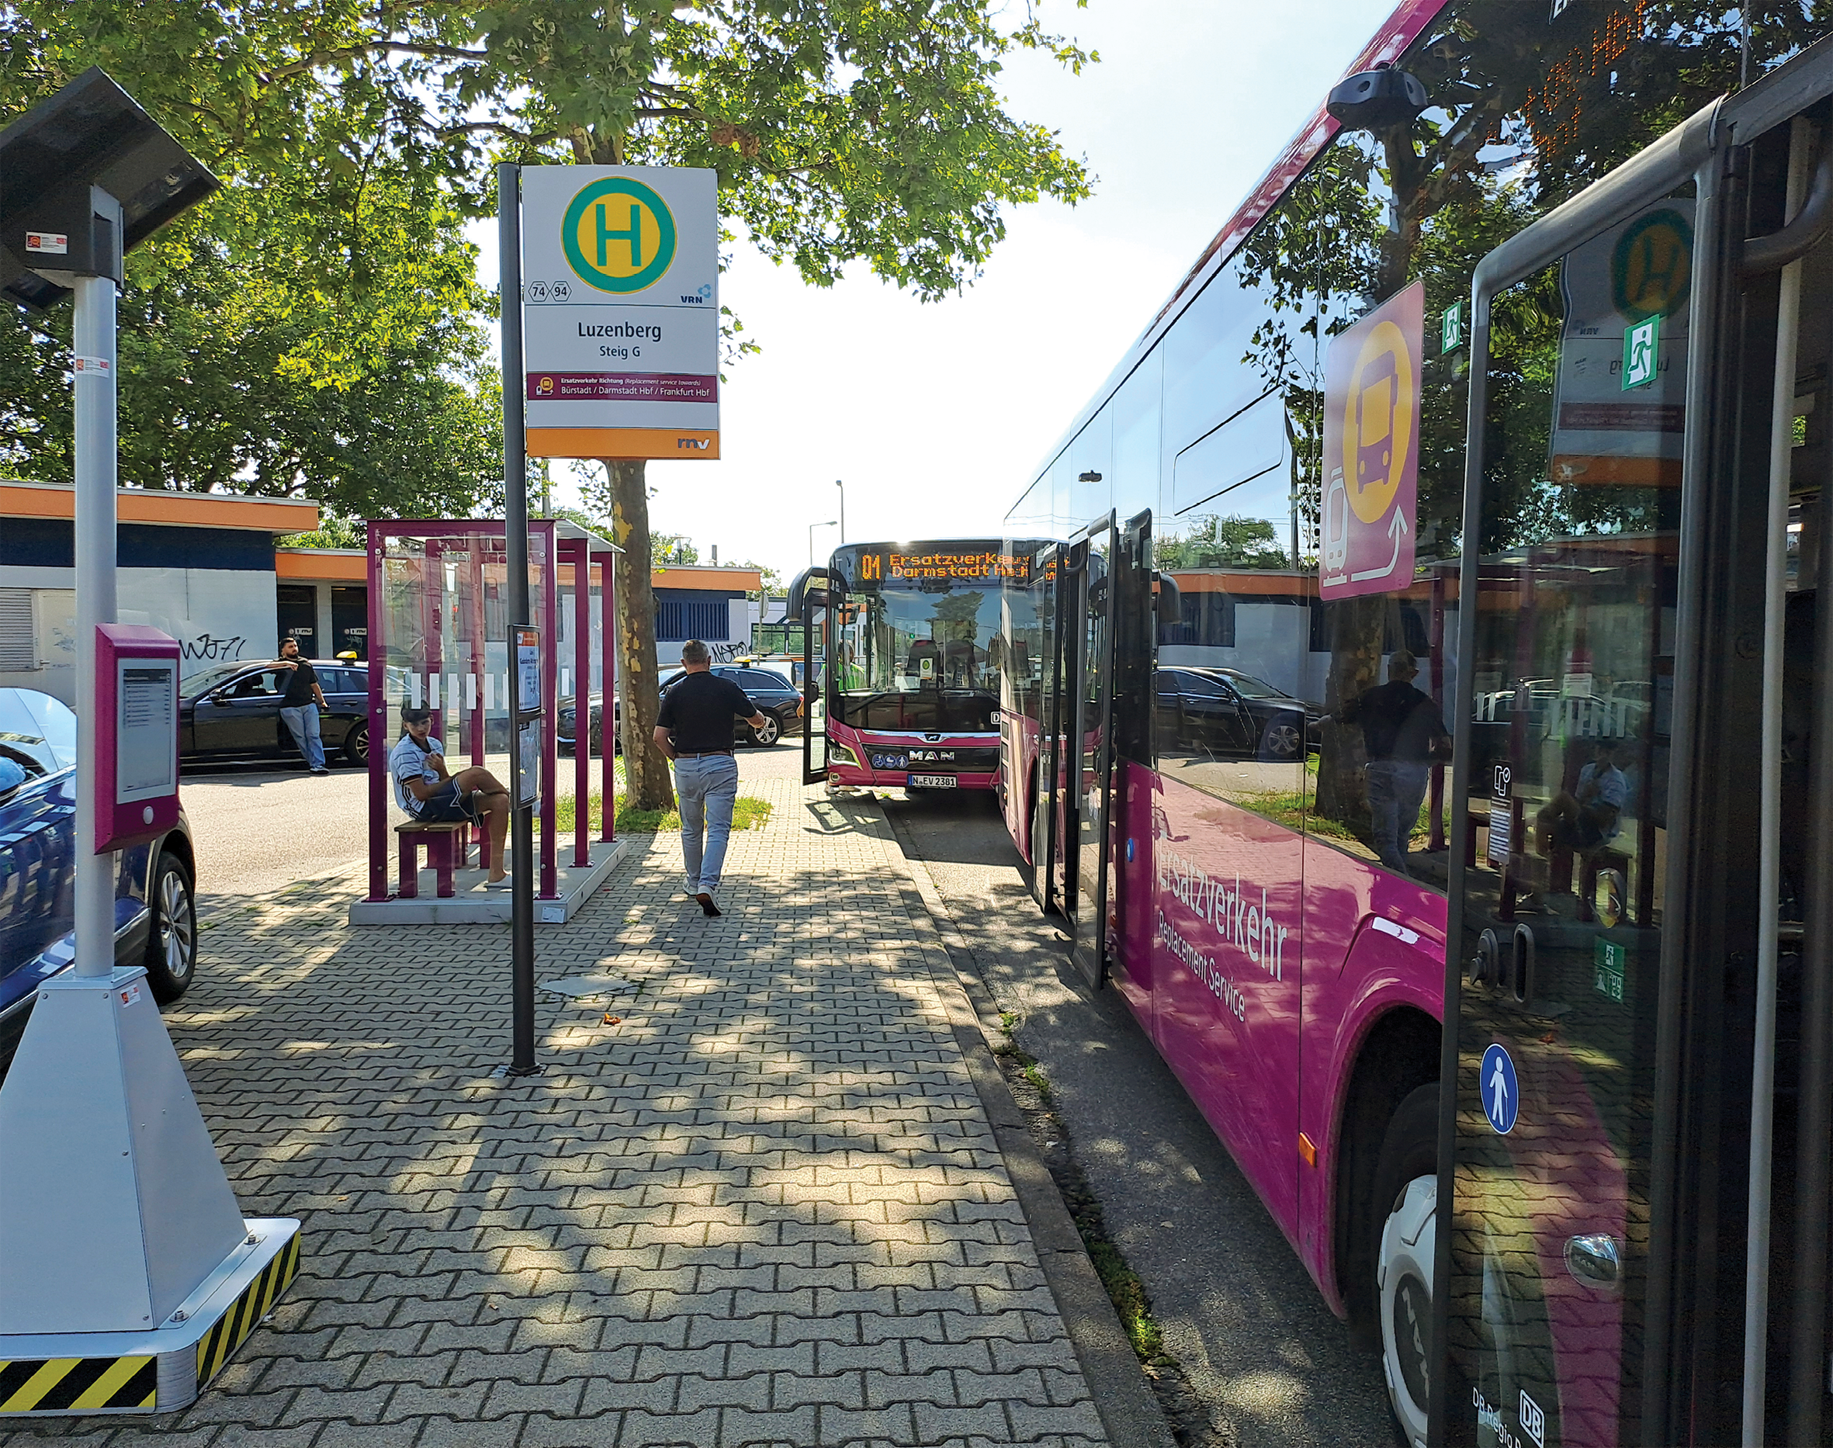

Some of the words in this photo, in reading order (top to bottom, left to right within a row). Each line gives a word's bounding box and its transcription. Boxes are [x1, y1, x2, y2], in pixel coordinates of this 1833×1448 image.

[595, 203, 642, 267] H
[532, 286, 546, 298] 74
[554, 286, 568, 298] 94
[680, 295, 703, 304] VRN
[578, 322, 662, 342] Luzenberg
[599, 345, 629, 360] Steig
[632, 346, 641, 358] G
[561, 377, 598, 385] Ersatzverkehr
[599, 378, 624, 386] Richtung
[561, 386, 592, 395] Bürstadt
[599, 386, 638, 395] Darmstadt
[639, 387, 654, 396] Hbf
[660, 387, 694, 397] Frankfurt
[695, 389, 711, 398] Hbf
[891, 564, 990, 578] Darmstadt
[909, 750, 955, 761] MAN
[1159, 828, 1288, 982] Ersatzverkehr
[1158, 909, 1208, 985] Replacement
[1208, 957, 1246, 1023] Service
[1473, 1386, 1486, 1415] DB
[1487, 1403, 1513, 1448] Regio
[1522, 1397, 1542, 1439] DB
